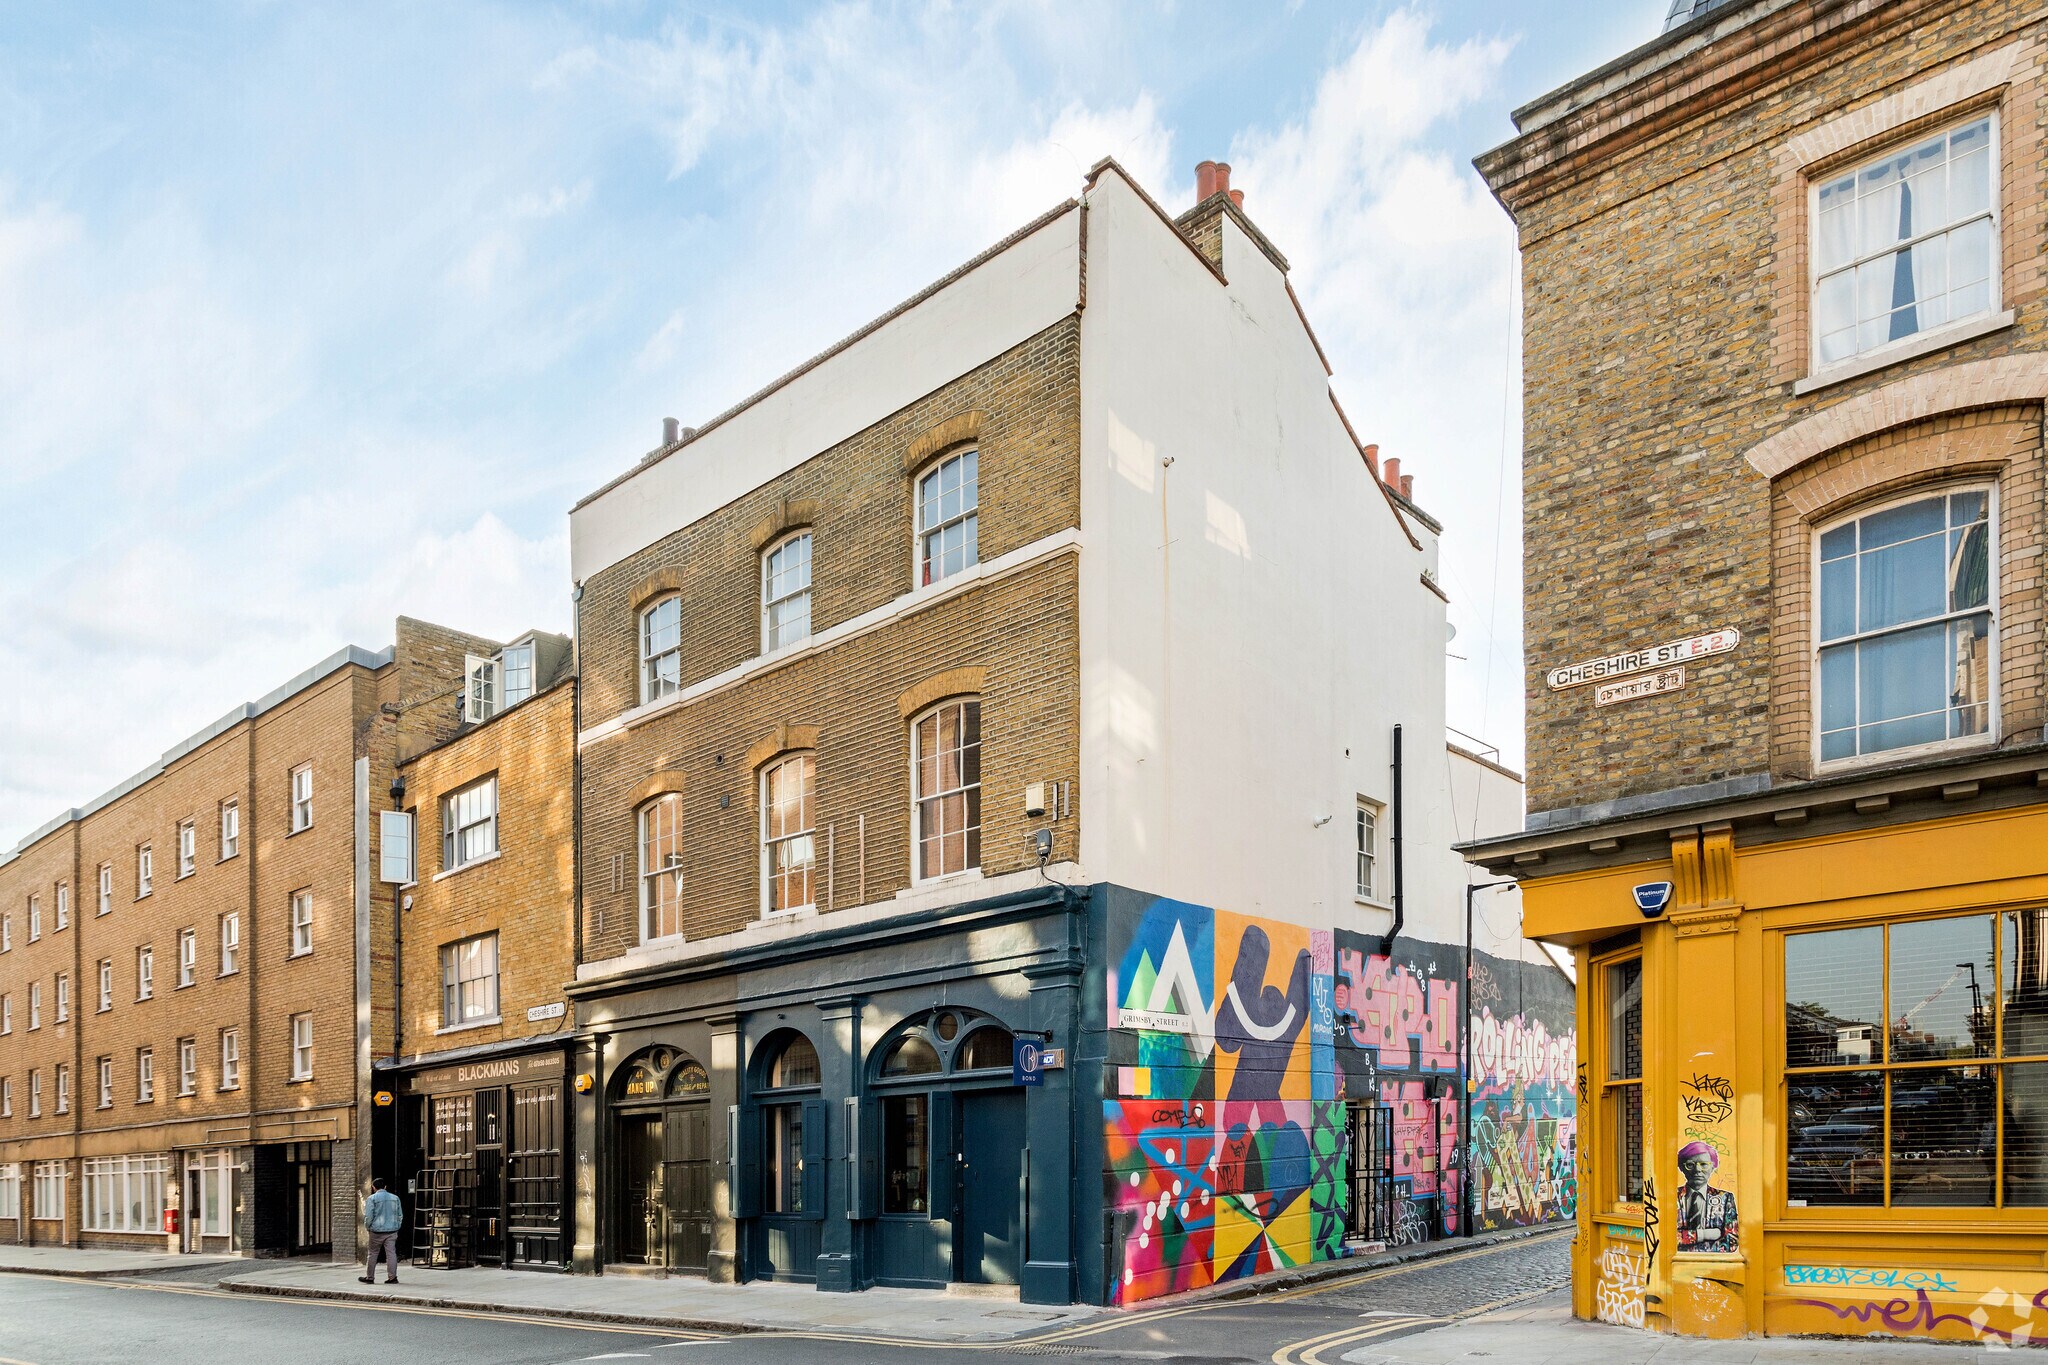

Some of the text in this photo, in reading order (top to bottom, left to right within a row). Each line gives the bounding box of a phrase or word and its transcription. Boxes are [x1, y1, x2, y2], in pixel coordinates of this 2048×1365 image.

[1556, 652, 1649, 685] CHESHIRE
[528, 1007, 549, 1019] CHESHIRE
[1124, 1015, 1151, 1024] GRIMSBY
[1157, 1018, 1179, 1026] STREET
[458, 1060, 519, 1081] BLACKMANS
[646, 1082, 654, 1093] UP
[436, 1124, 450, 1134] OPEN
